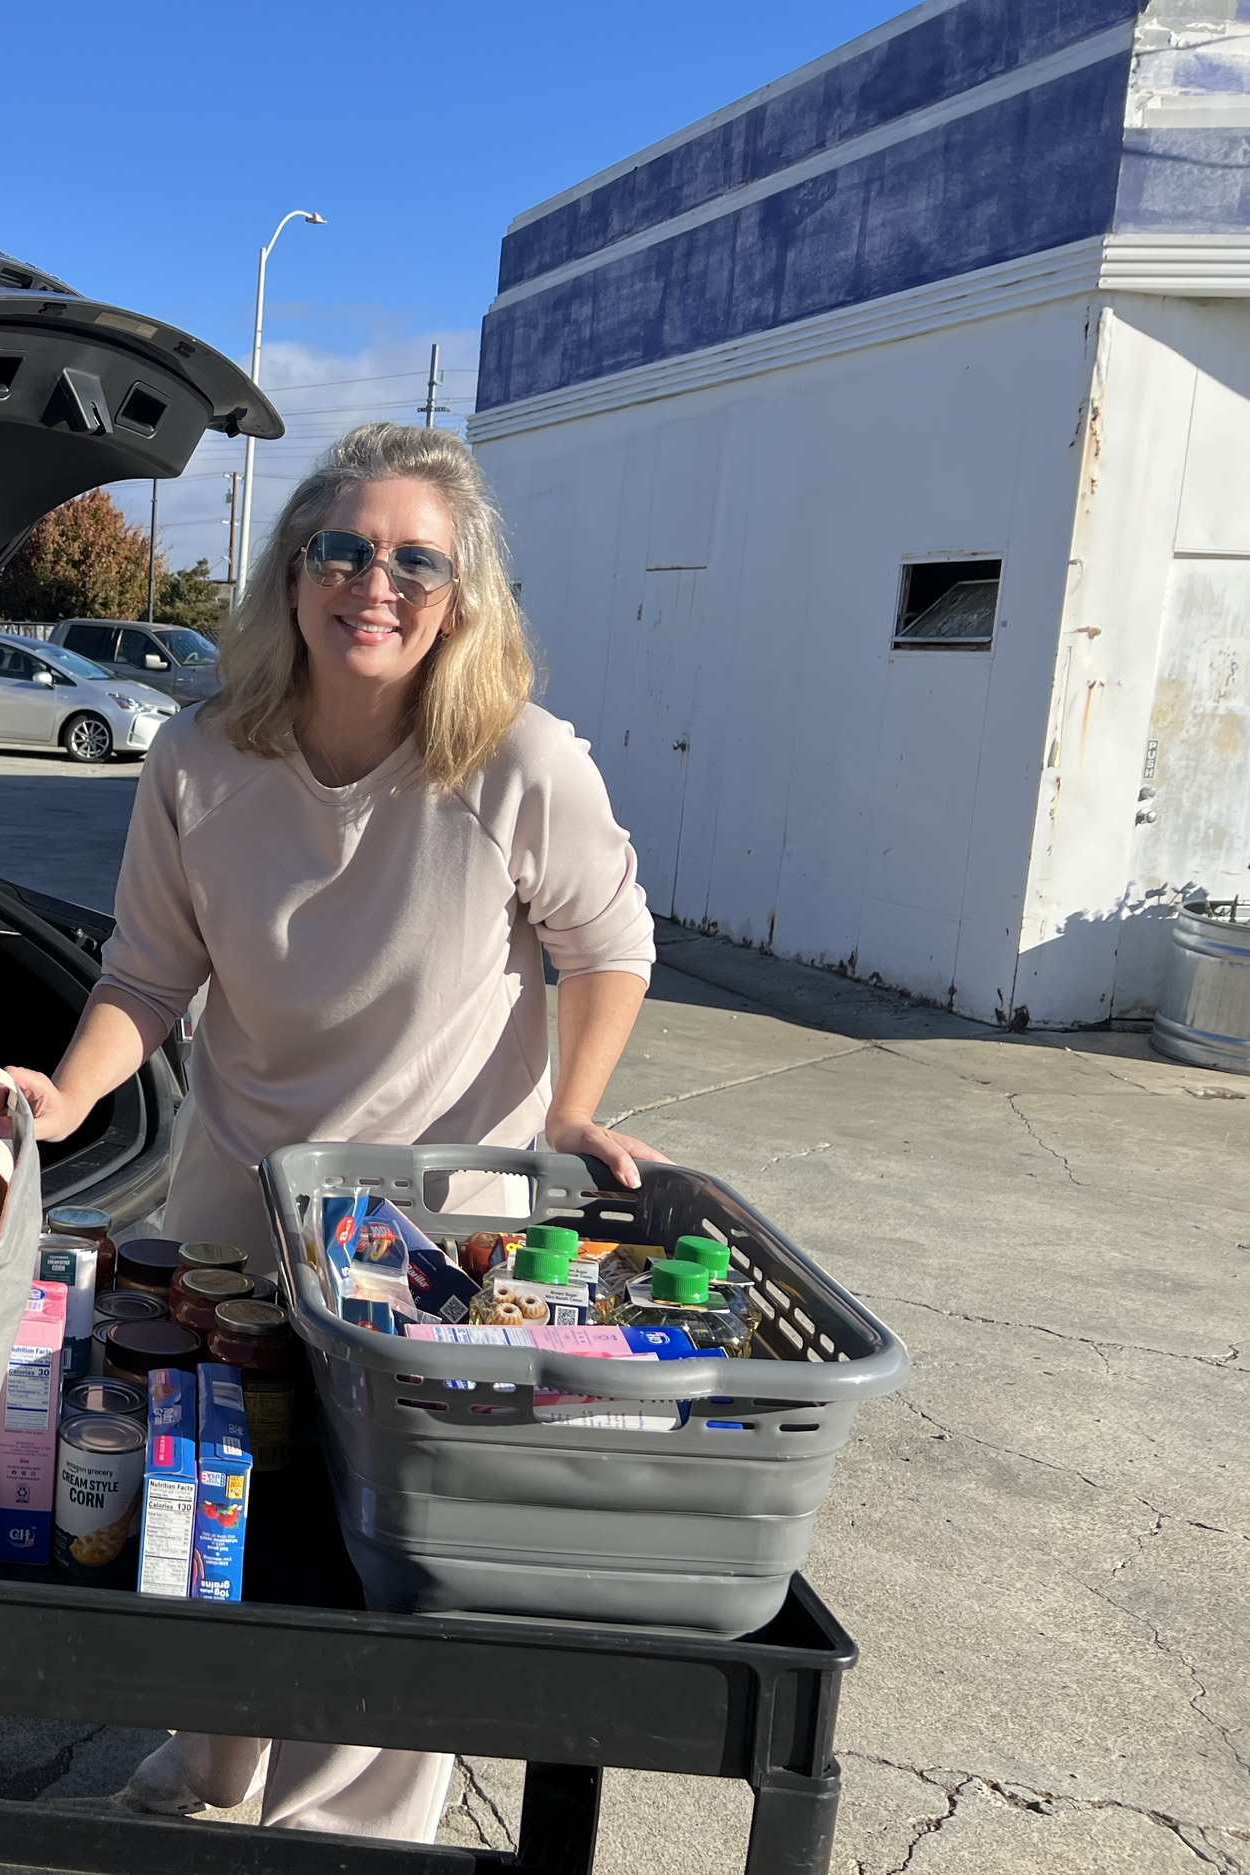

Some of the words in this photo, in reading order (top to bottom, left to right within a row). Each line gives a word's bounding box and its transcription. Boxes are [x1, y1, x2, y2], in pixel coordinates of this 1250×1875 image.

[1144, 741, 1157, 778] PUSH
[9, 1368, 35, 1376] Calories
[38, 1368, 50, 1376] 30
[66, 1460, 87, 1473] amazon
[87, 1467, 114, 1477] grocery
[62, 1469, 88, 1489] CREAM
[89, 1480, 119, 1492] STYLE
[150, 1480, 176, 1490] Nutrition
[177, 1483, 193, 1492] Facts
[69, 1487, 105, 1509] CORN
[148, 1500, 174, 1510] Calories
[177, 1503, 192, 1511] 130
[201, 1580, 230, 1589] grains
[214, 1588, 230, 1597] 10g
